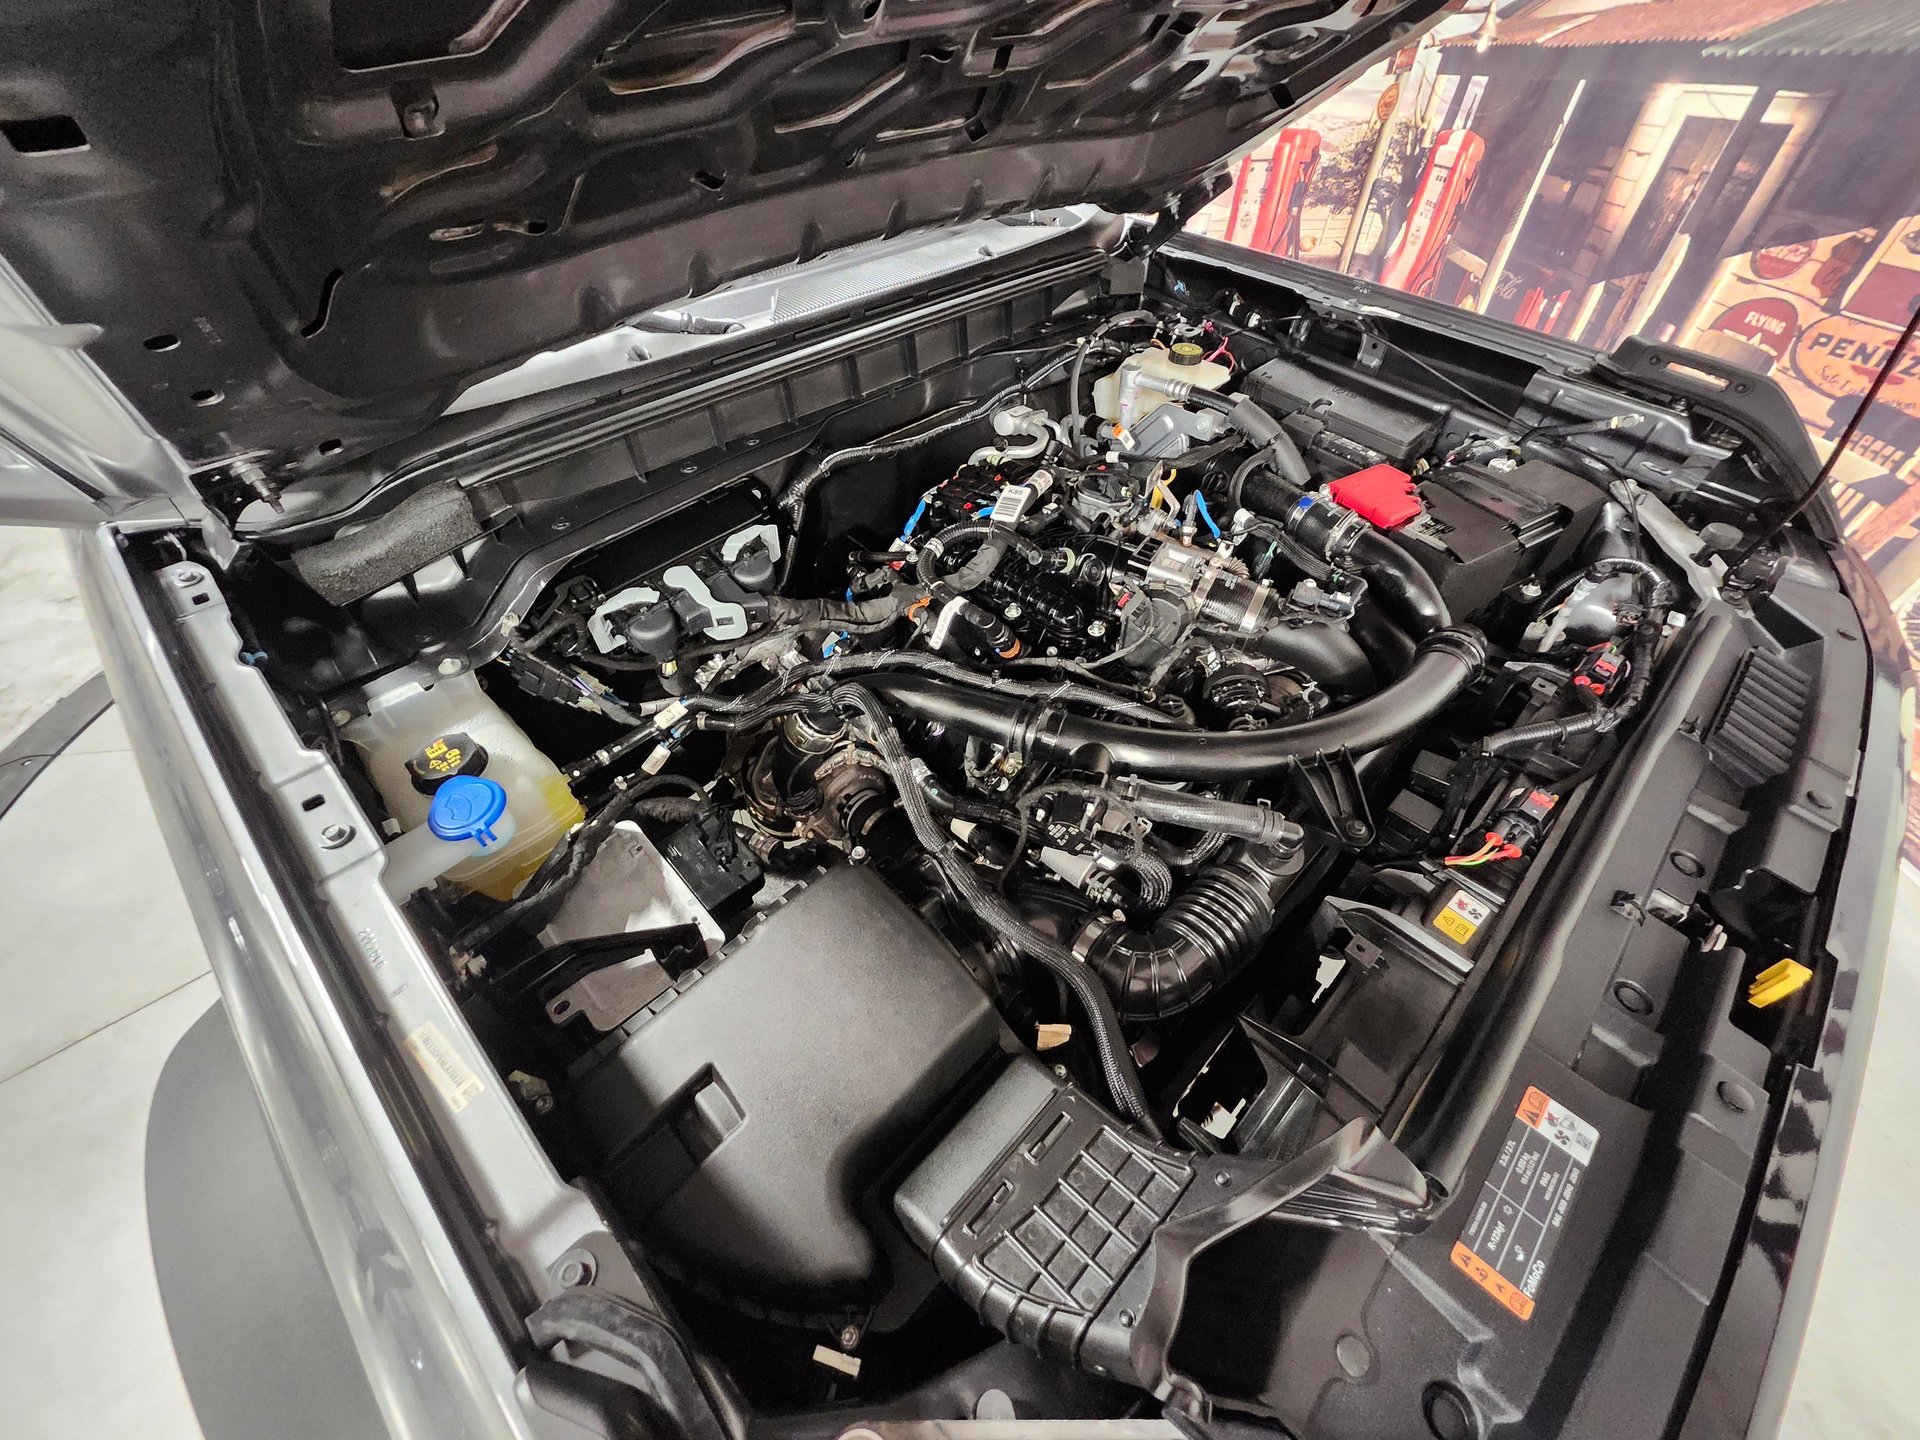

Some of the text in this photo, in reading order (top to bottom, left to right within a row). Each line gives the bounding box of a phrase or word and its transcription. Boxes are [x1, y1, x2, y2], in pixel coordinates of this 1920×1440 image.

[1744, 311, 1786, 335] FLYING
[1808, 332, 1920, 378] PENNZ
[1540, 1171, 1551, 1187] PAG
[1523, 1259, 1546, 1298] FoMoCo
